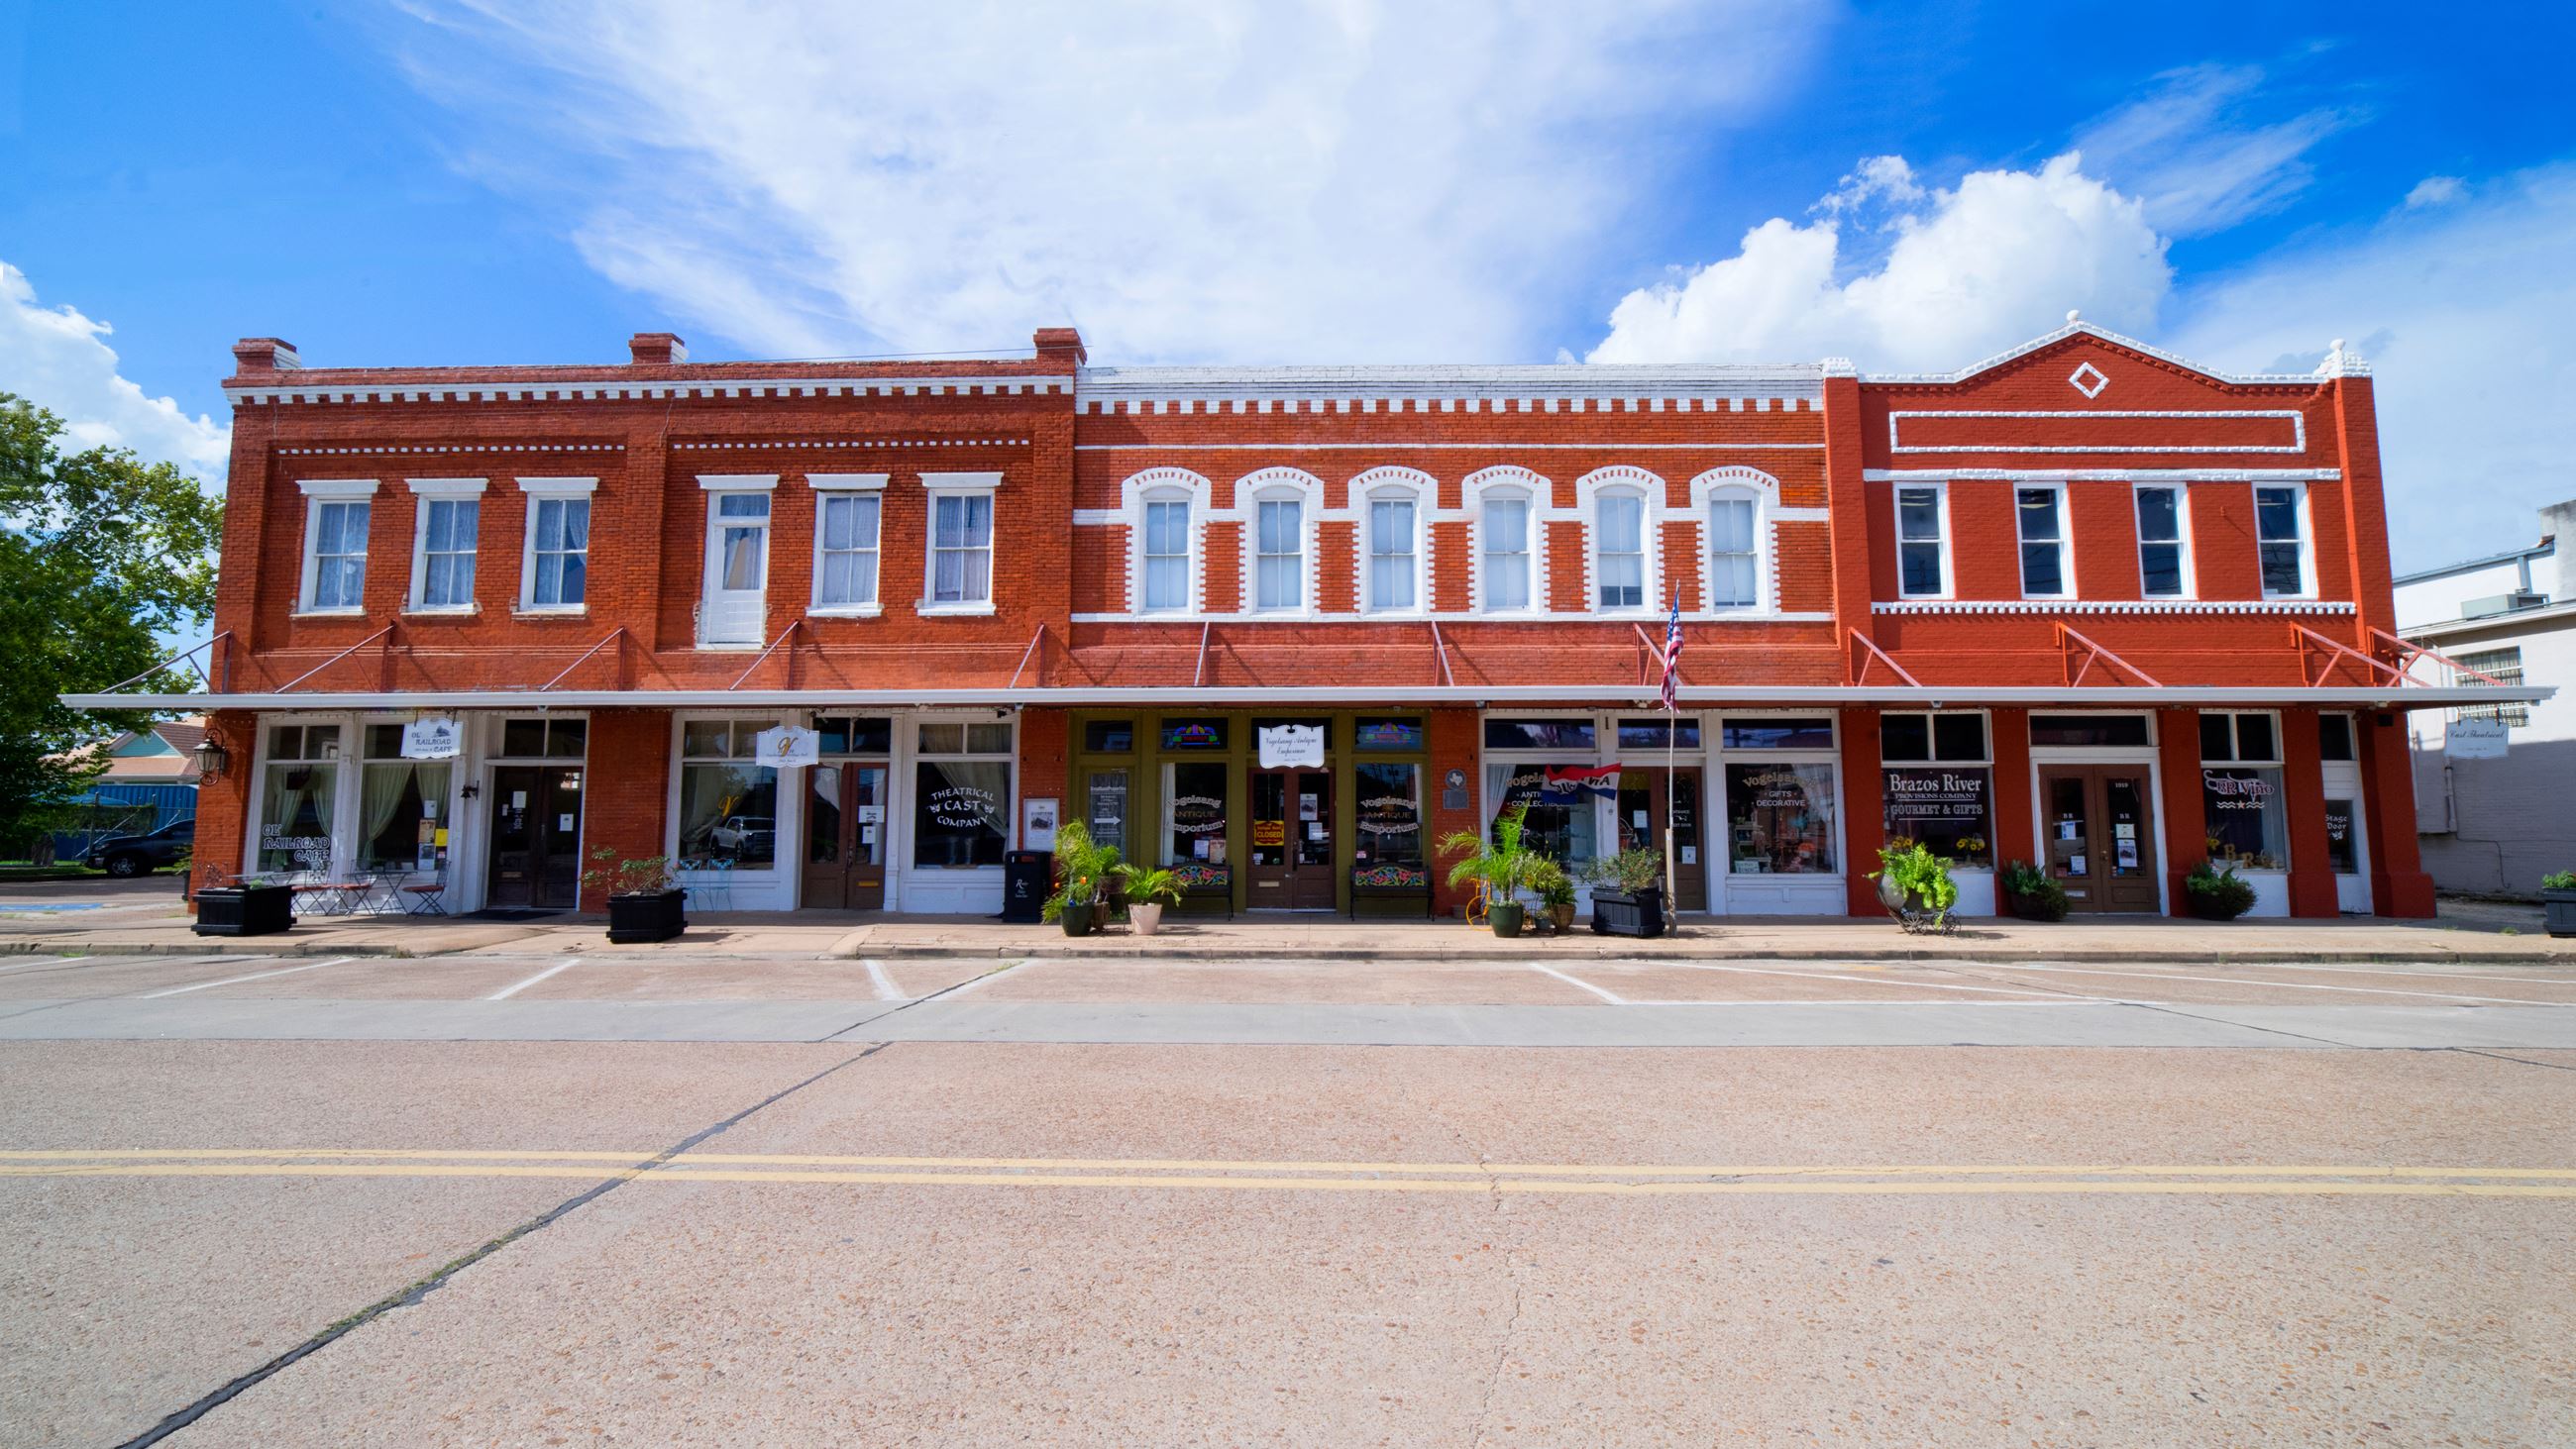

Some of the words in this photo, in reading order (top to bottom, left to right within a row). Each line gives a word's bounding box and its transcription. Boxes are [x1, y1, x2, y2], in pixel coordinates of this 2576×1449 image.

[1889, 774, 1939, 791] Brazos
[1943, 774, 1982, 791] River
[2238, 779, 2275, 796] Vino
[931, 786, 994, 801] THEATRICAL
[944, 799, 982, 811] CAST
[1359, 795, 1418, 810] Vogelsang
[1890, 804, 1940, 815] GOURMET
[1942, 804, 1951, 814] &
[1953, 804, 1984, 814] GIFTS
[937, 814, 989, 828] COMPANY
[2325, 814, 2347, 823] Stage
[1256, 830, 1282, 839] CLOSED
[1359, 821, 1419, 835] Emporium
[263, 836, 330, 850] RAILROAD
[293, 849, 329, 862] CAFE
